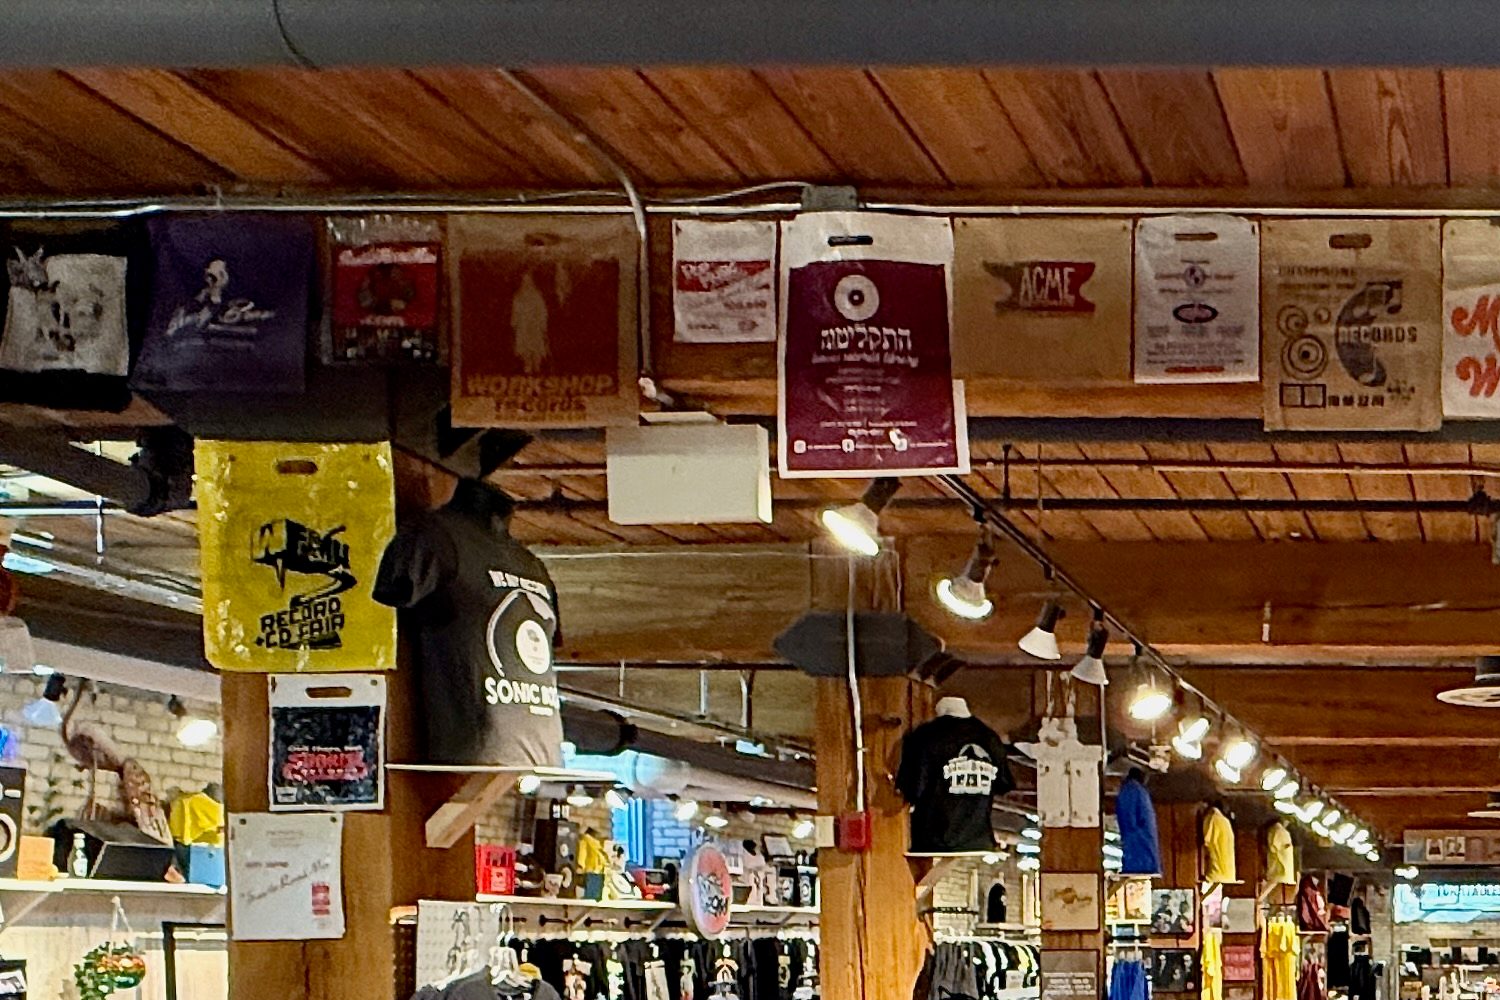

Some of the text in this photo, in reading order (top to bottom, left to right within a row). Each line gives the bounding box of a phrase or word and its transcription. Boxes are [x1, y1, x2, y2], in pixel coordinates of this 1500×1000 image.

[1019, 265, 1076, 307] ACME
[1337, 325, 1418, 344] RECORDS
[466, 374, 615, 396] WORKSHOP
[259, 597, 341, 634] RECORD
[299, 613, 345, 641] FAIR
[485, 677, 541, 705] SONIC
